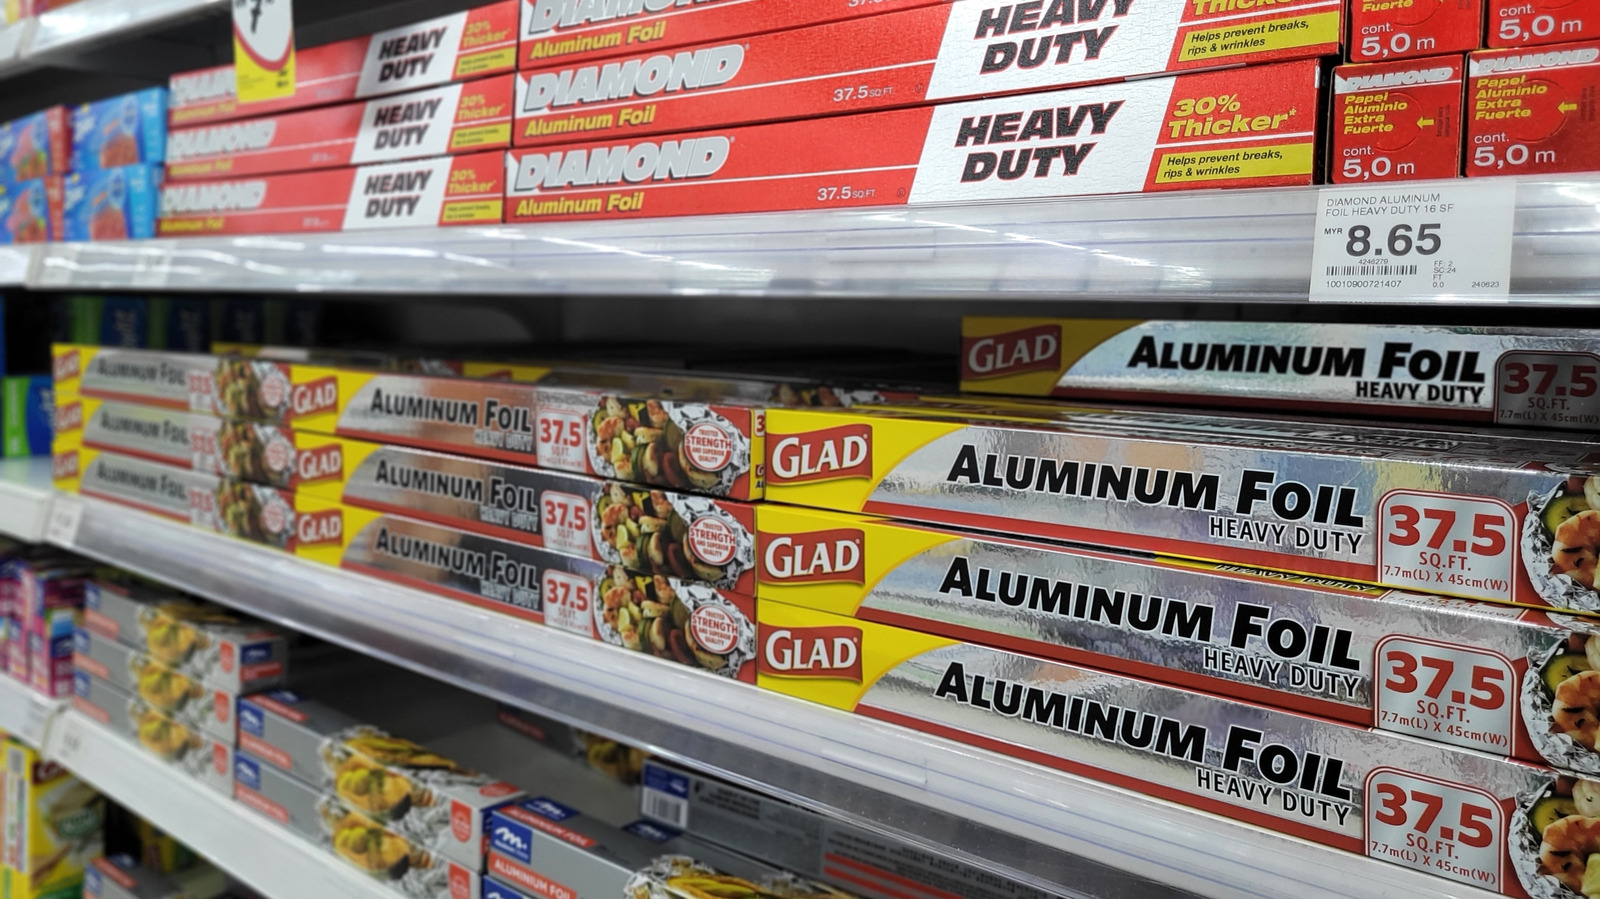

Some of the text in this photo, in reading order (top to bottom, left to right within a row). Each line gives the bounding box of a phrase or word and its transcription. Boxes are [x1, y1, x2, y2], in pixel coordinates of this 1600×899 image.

[1499, 5, 1535, 17] cont.
[466, 20, 491, 35] 30%
[530, 20, 667, 60] Aluminum Foil
[1191, 20, 1309, 44] Helps prevent breaks,
[1361, 22, 1393, 34] cont.
[1499, 15, 1582, 41] 5,0 m
[378, 26, 448, 60] HEAVY
[979, 24, 1120, 75] DUTY
[1187, 38, 1266, 56] rips & wrinkles
[1361, 33, 1435, 58] 5,0 m
[379, 53, 435, 82] DUTY
[1478, 48, 1599, 74] DIAMOND
[523, 43, 745, 112] DIAMOND
[1345, 67, 1453, 91] DIAMOND
[1477, 75, 1526, 88] Papel
[461, 94, 485, 107] 30%
[833, 85, 869, 102] 37.5
[1345, 92, 1389, 104] Papel
[1475, 84, 1548, 99] Aluminio
[1476, 99, 1521, 109] Extra
[373, 97, 443, 127] HEAVY
[1173, 94, 1241, 118] 30%
[1344, 101, 1408, 114] Aluminio
[1344, 114, 1385, 124] Extra
[1475, 108, 1531, 120] Fuerte
[524, 113, 613, 137] Aluminum
[618, 105, 657, 126] Foil
[954, 99, 1126, 148] HEAVY
[1344, 123, 1394, 135] Fuerte
[374, 124, 430, 150] DUTY
[1474, 132, 1509, 144] cont.
[514, 135, 731, 192] DIAMOND
[960, 142, 1098, 183] DUTY
[1167, 150, 1283, 168] Helps prevent breaks,
[1343, 145, 1374, 156] cont.
[1474, 144, 1555, 169] 5,0 m
[451, 169, 476, 182] 30%
[1163, 165, 1240, 179] rips & wrinkles
[1342, 157, 1415, 180] 5,0 m
[364, 169, 433, 195] HEAVY
[817, 186, 851, 201] 37.5
[365, 195, 421, 218] DUTY
[515, 192, 645, 216] Aluminum Foil
[1325, 204, 1454, 217] FOIL HEAVY DUTY 16 SF
[1327, 193, 1440, 207] DIAMOND ALUMINUM
[1346, 223, 1441, 256] 8.65
[1326, 280, 1402, 288] 10010900721407
[968, 334, 1057, 373] GLAD
[1126, 335, 1485, 383] ALUMINUM FOIL
[1356, 381, 1485, 404] HEAVY DUTY
[1503, 362, 1598, 398] 37.5
[293, 382, 337, 414] GLAD
[370, 387, 532, 433] ALUMINUM FOIL
[1527, 396, 1570, 412] SQ.FT.
[1540, 412, 1548, 421] X
[540, 418, 581, 447] 37.5
[685, 435, 731, 449] STRENGTH
[699, 429, 718, 437] TRUSTED
[299, 450, 341, 479] GLAD
[772, 435, 867, 478] GLAD
[375, 459, 537, 514] ALUMINUM FOIL
[946, 444, 1365, 529] ALUMINUM FOIL
[298, 514, 342, 542] GLAD
[544, 499, 586, 531] 37.5
[702, 522, 723, 531] TRUSTED
[690, 528, 736, 545] STRENGTH
[1209, 515, 1364, 555] HEAVY DUTY
[1388, 505, 1506, 556] 37.5
[376, 527, 539, 591] ALUMINUM FOIL
[764, 537, 860, 578] GLAD
[1419, 552, 1471, 571] SQ.FT.
[1384, 565, 1509, 592] 7.7m(L) X 45cm(W)
[546, 578, 588, 612] 37.5
[692, 615, 738, 634] STRENGTH
[705, 610, 725, 620] TRUSTED
[938, 556, 1360, 671] ALUMINUM FOIL
[765, 630, 857, 671] GLAD
[1203, 647, 1361, 699] HEAVY DUTY
[1385, 651, 1505, 710] 37.5
[1416, 700, 1470, 723] SQ.FT.
[933, 661, 1352, 801] ALUMINUM FOIL
[1381, 710, 1507, 747] 7.7m(L) X 45cm(W)
[1196, 767, 1351, 826] HEAVY DUTY
[1375, 783, 1493, 848] 37.5
[1406, 833, 1458, 859] SQ.FT.
[494, 858, 548, 890] ALUMINIUM
[1371, 841, 1496, 885] 7.7m(L) X 45cm(W)
